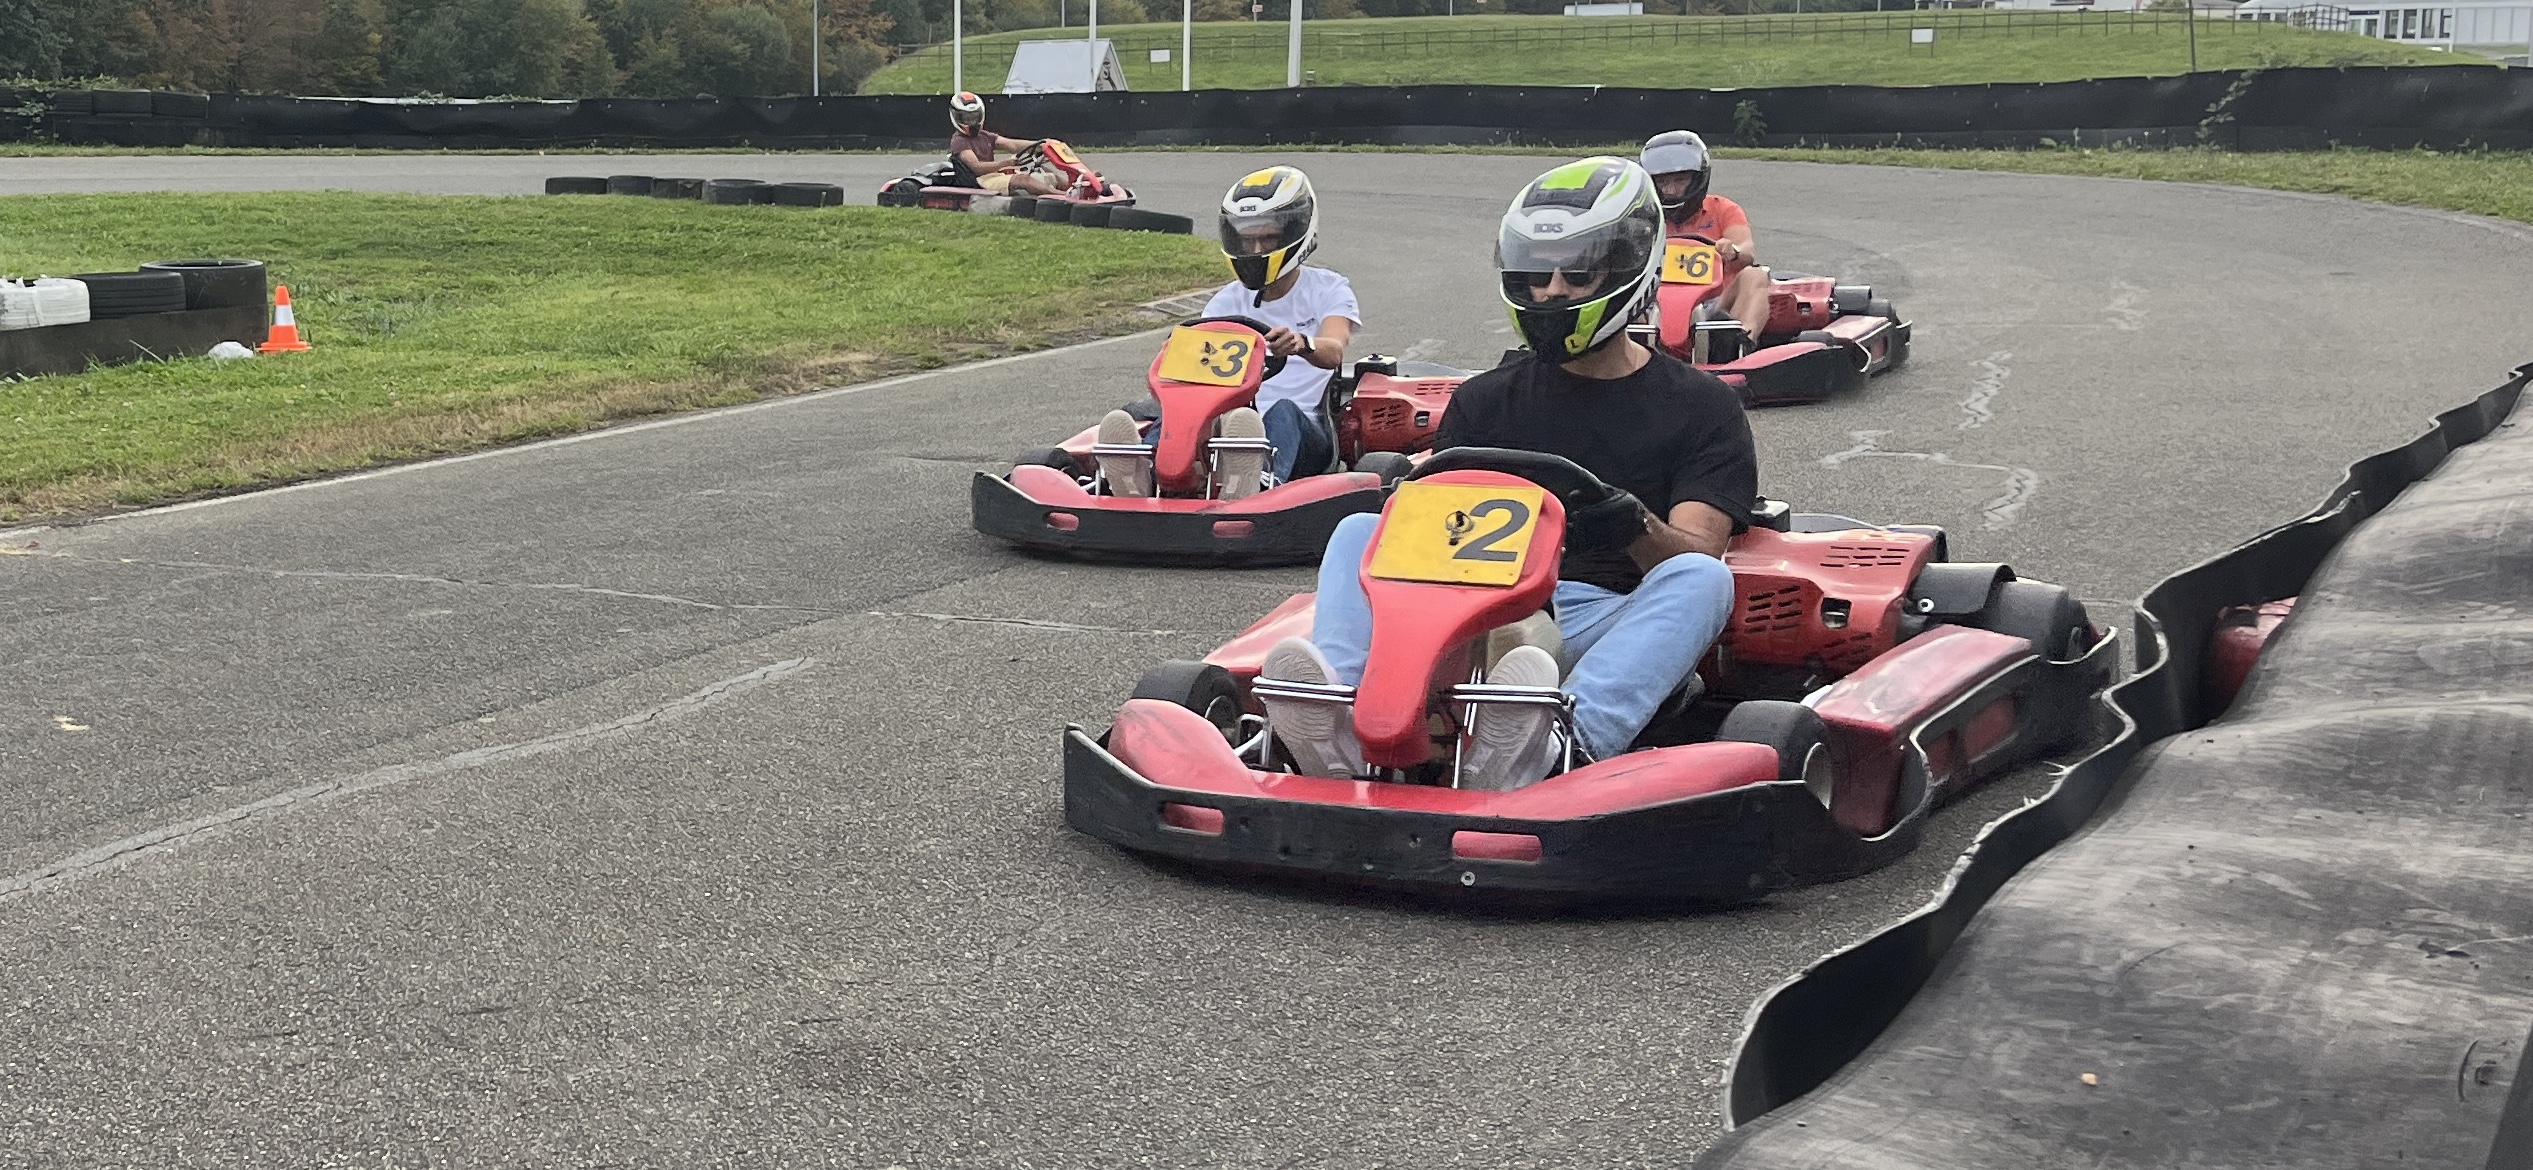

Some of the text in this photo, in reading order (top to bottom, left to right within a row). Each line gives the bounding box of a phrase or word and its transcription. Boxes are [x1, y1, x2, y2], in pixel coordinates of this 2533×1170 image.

[1687, 251, 1711, 277] 6
[1211, 340, 1248, 377] 3
[1452, 499, 1530, 562] 2
